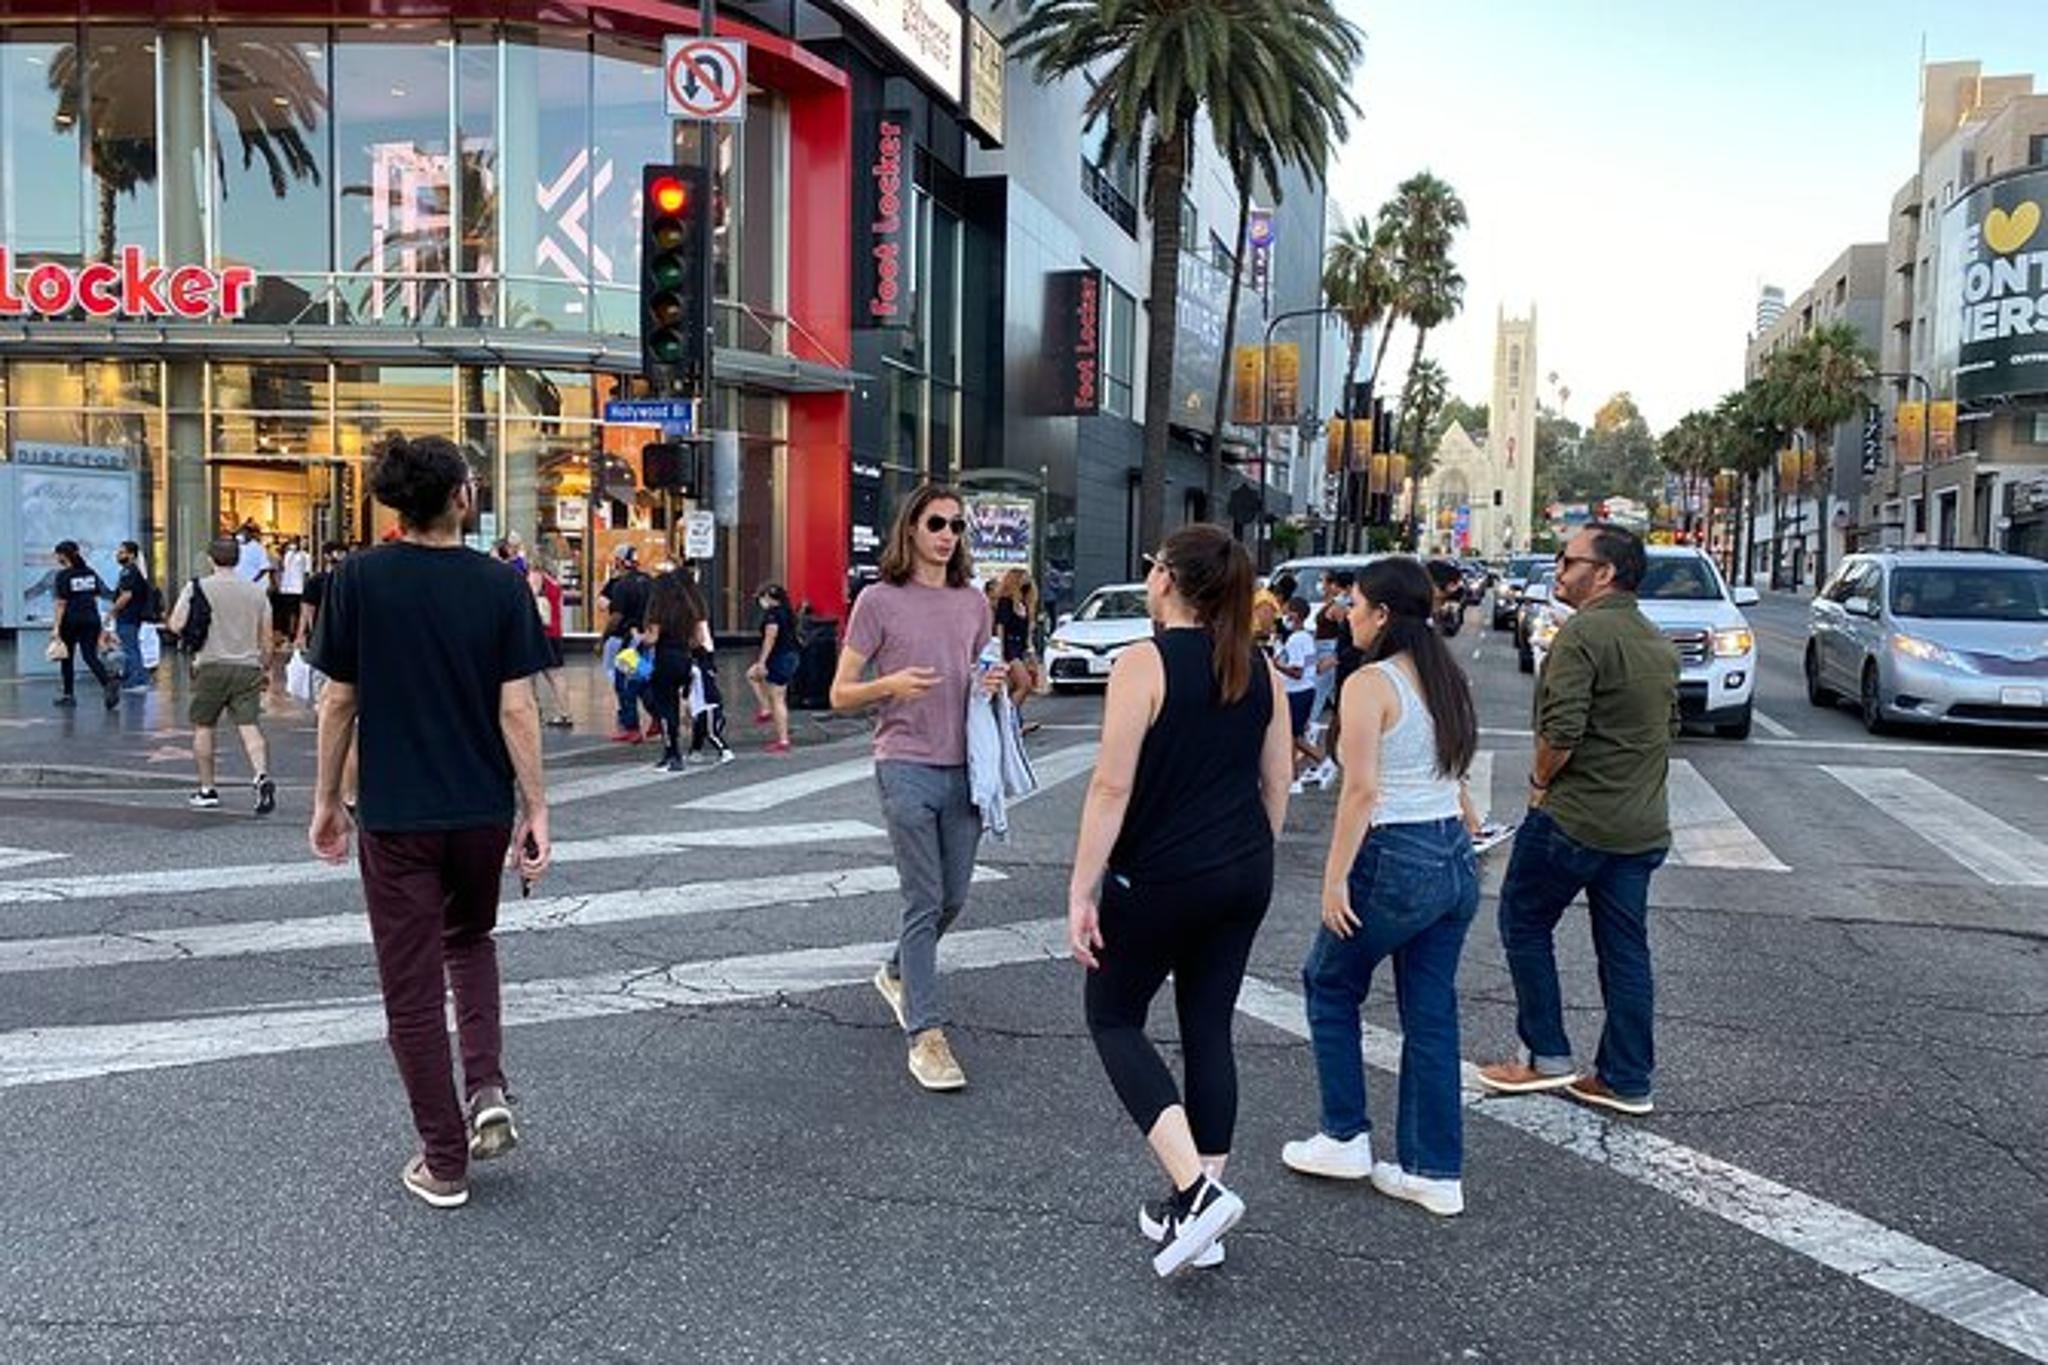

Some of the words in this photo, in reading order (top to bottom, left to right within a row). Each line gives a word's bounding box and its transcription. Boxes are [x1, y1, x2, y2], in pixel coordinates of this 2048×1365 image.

[872, 121, 901, 235] Locker
[0, 244, 257, 319] Locker
[870, 243, 898, 317] Foot
[1076, 275, 1098, 353] Locker
[611, 404, 669, 422] Hollywood
[1075, 358, 1097, 410] Foot
